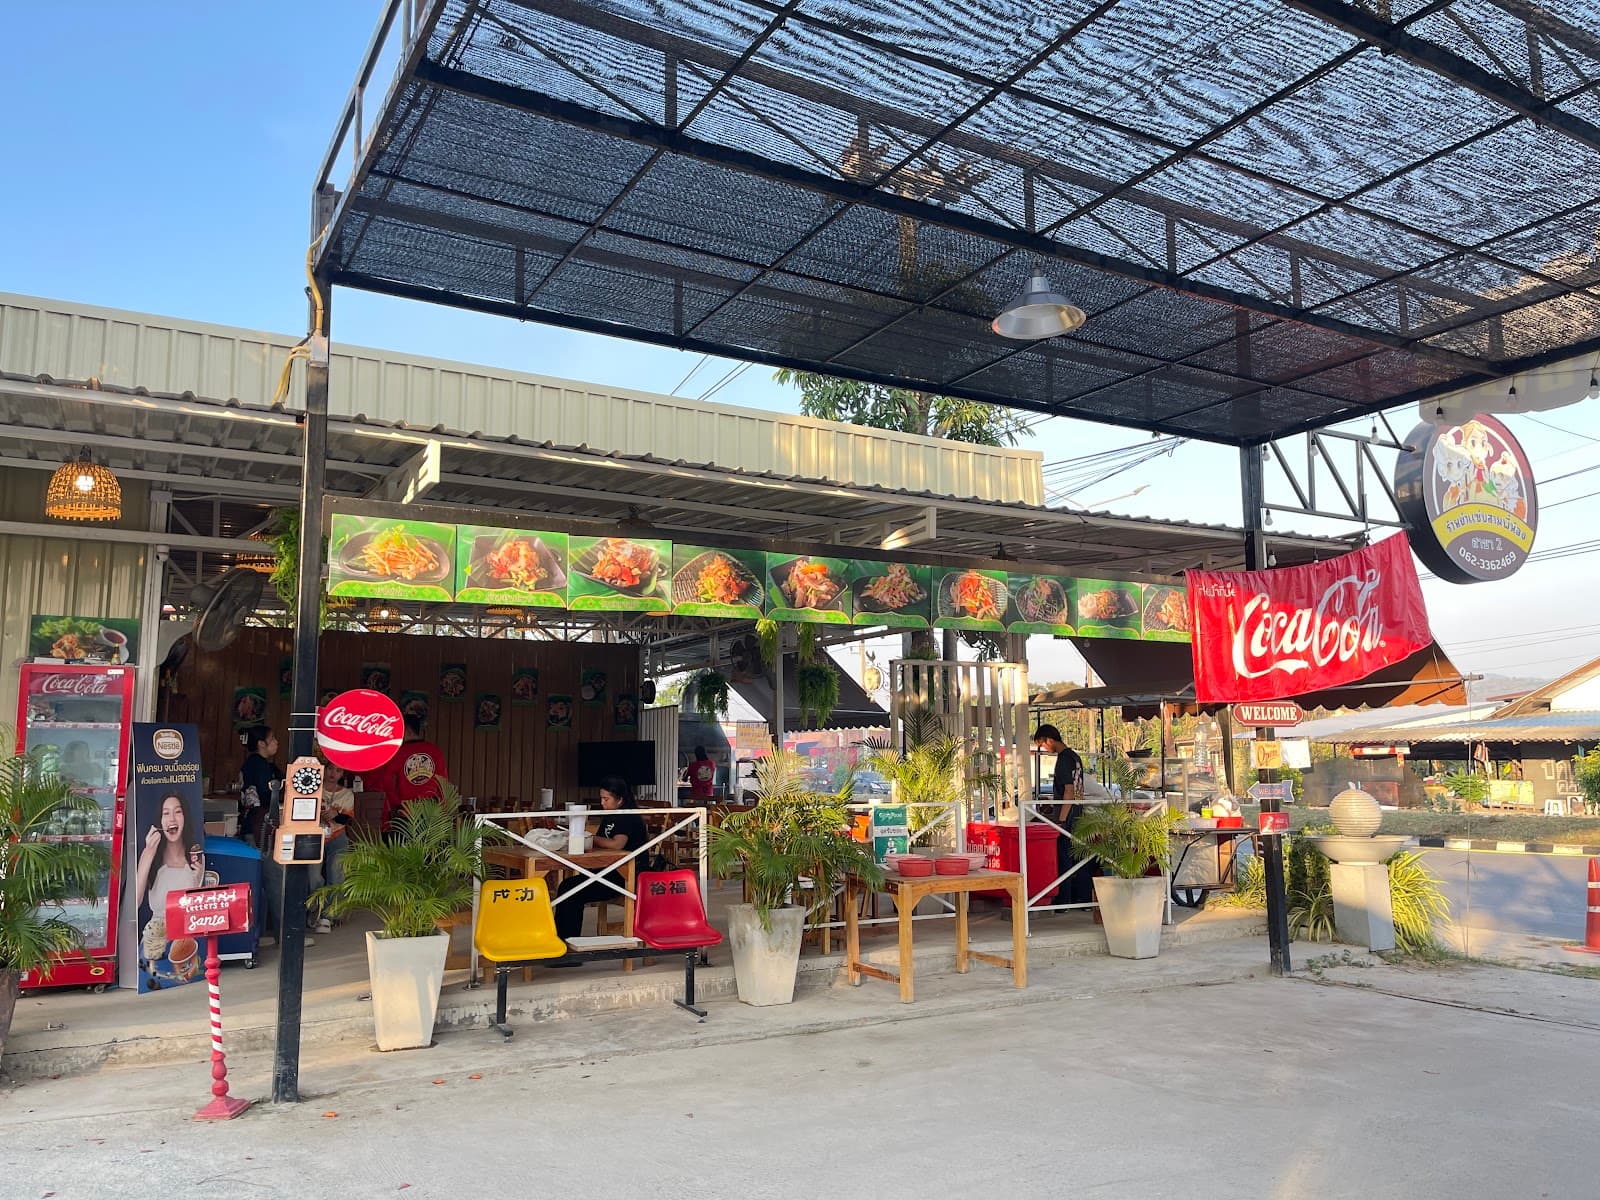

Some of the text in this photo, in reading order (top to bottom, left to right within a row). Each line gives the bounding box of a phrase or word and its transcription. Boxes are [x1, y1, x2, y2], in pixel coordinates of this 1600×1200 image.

[1496, 537, 1504, 551] 2
[1458, 547, 1517, 570] 062-3362469
[324, 706, 401, 737] Coca-Cola
[1241, 706, 1298, 721] WELCOME
[650, 880, 688, 896] 裕福
[188, 914, 226, 931] Santa
